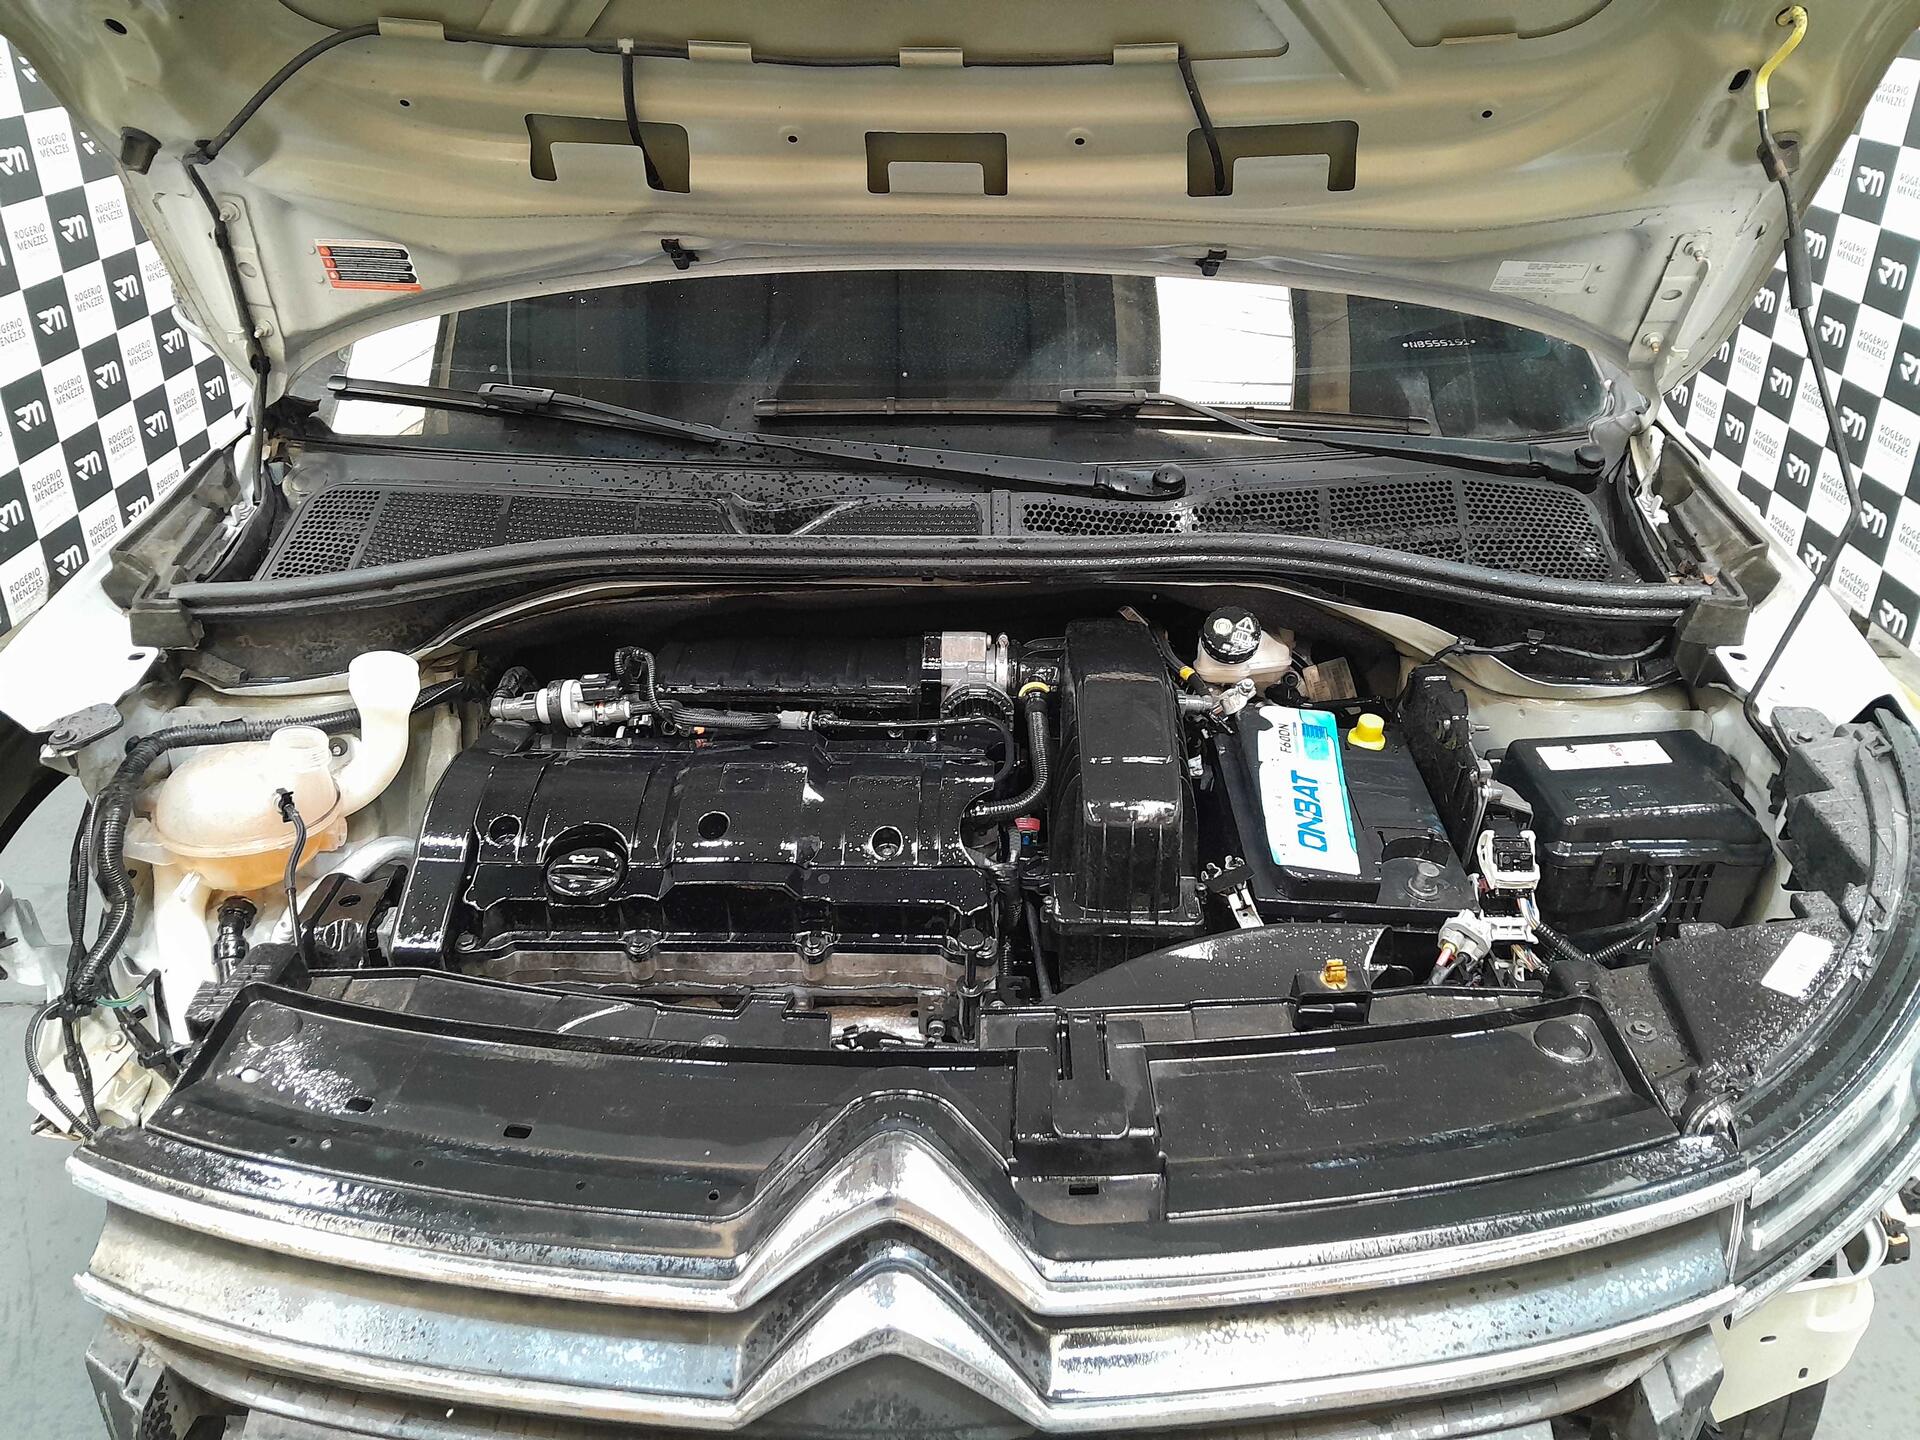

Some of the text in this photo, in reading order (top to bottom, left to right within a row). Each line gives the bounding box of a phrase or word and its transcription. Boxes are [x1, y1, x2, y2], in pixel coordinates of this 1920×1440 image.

[1875, 93, 1906, 107] MENEZES
[39, 144, 70, 158] MENEZES
[97, 209, 124, 224] MENEZES
[17, 234, 48, 251] MENEZES
[1837, 249, 1865, 267] MENEZES
[77, 295, 104, 313] MENEZES
[0, 329, 26, 347] ENEZES
[129, 349, 154, 366] MENEZES
[1857, 340, 1886, 361] MENEZES
[56, 385, 85, 405] MENEZES
[175, 397, 198, 415] MENEZES
[1695, 400, 1716, 419] MENEZES
[110, 434, 136, 455] MENEZES
[1753, 438, 1776, 459] MENEZES
[1877, 434, 1908, 458] MENEZES
[34, 479, 65, 503] MENEZES
[91, 523, 118, 547] MENEZES
[11, 577, 44, 605] MENEZES
[1838, 575, 1867, 602] MENEZES
[1290, 769, 1328, 853] ONBAT
